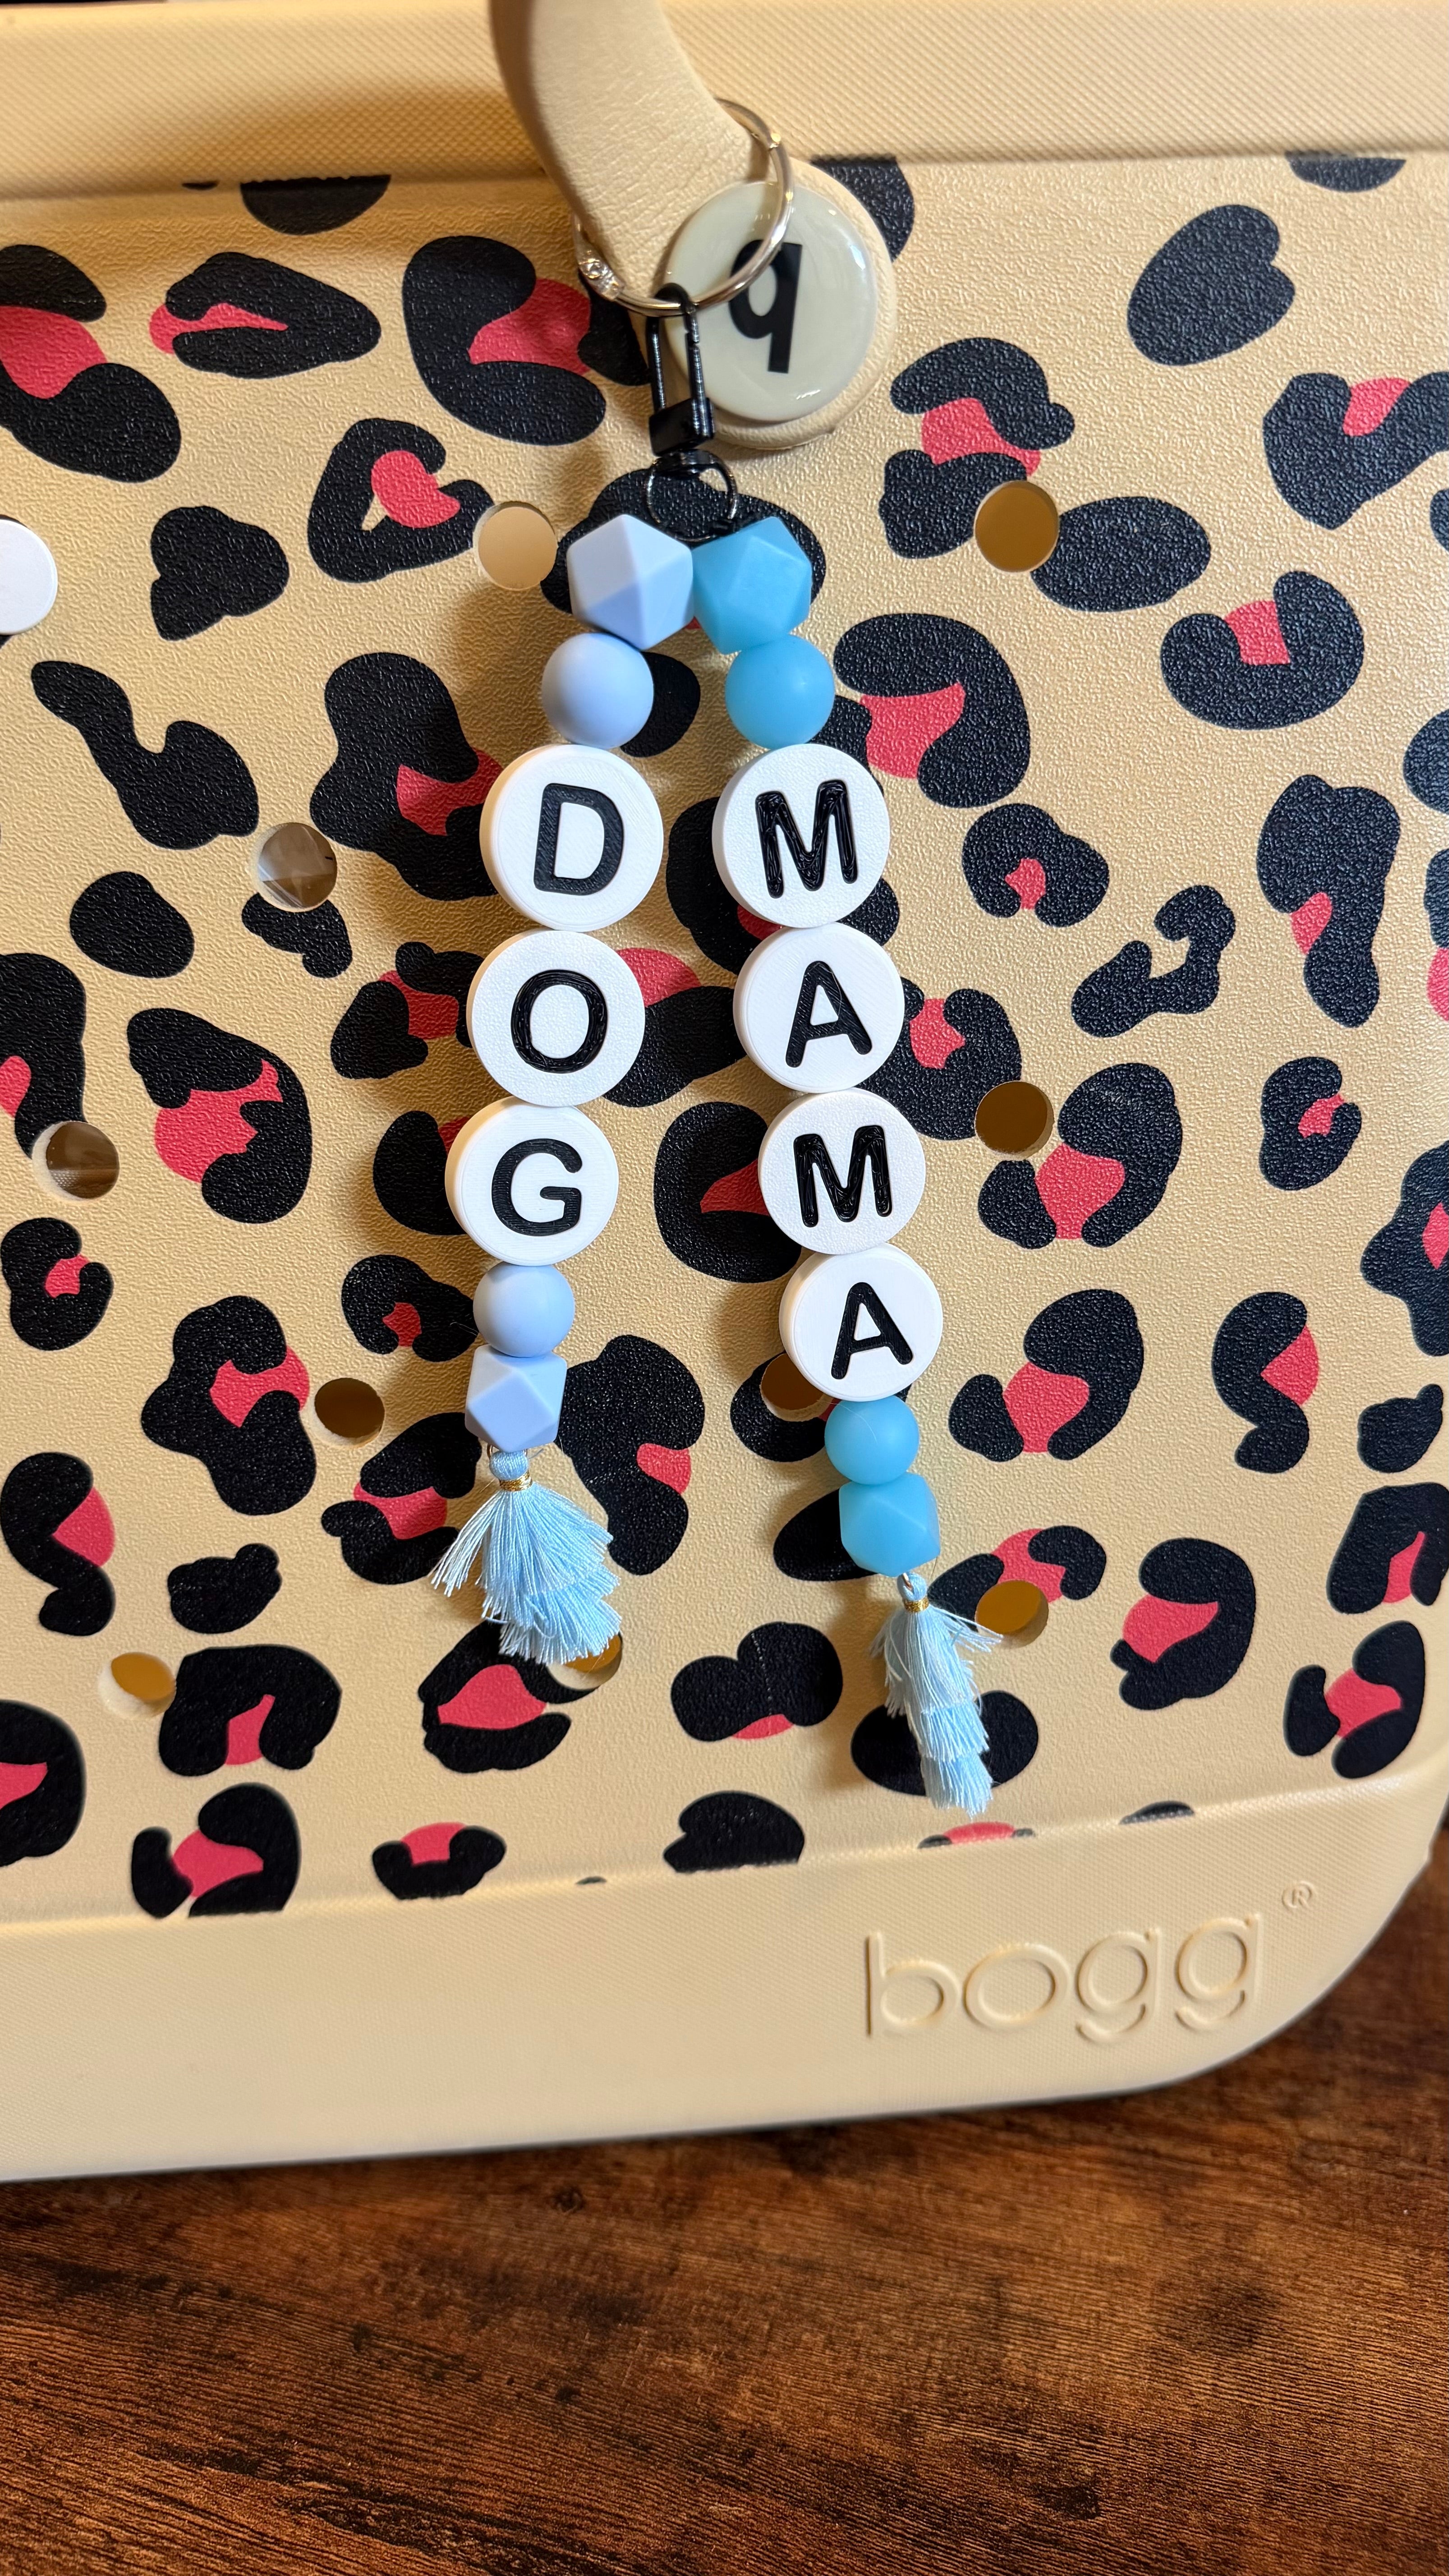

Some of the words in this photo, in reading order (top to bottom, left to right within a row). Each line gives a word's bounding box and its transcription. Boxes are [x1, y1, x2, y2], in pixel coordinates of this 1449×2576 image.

[491, 782, 625, 1237] DOG
[754, 778, 914, 1380] MAMA
[865, 1913, 1261, 2042] bogg
